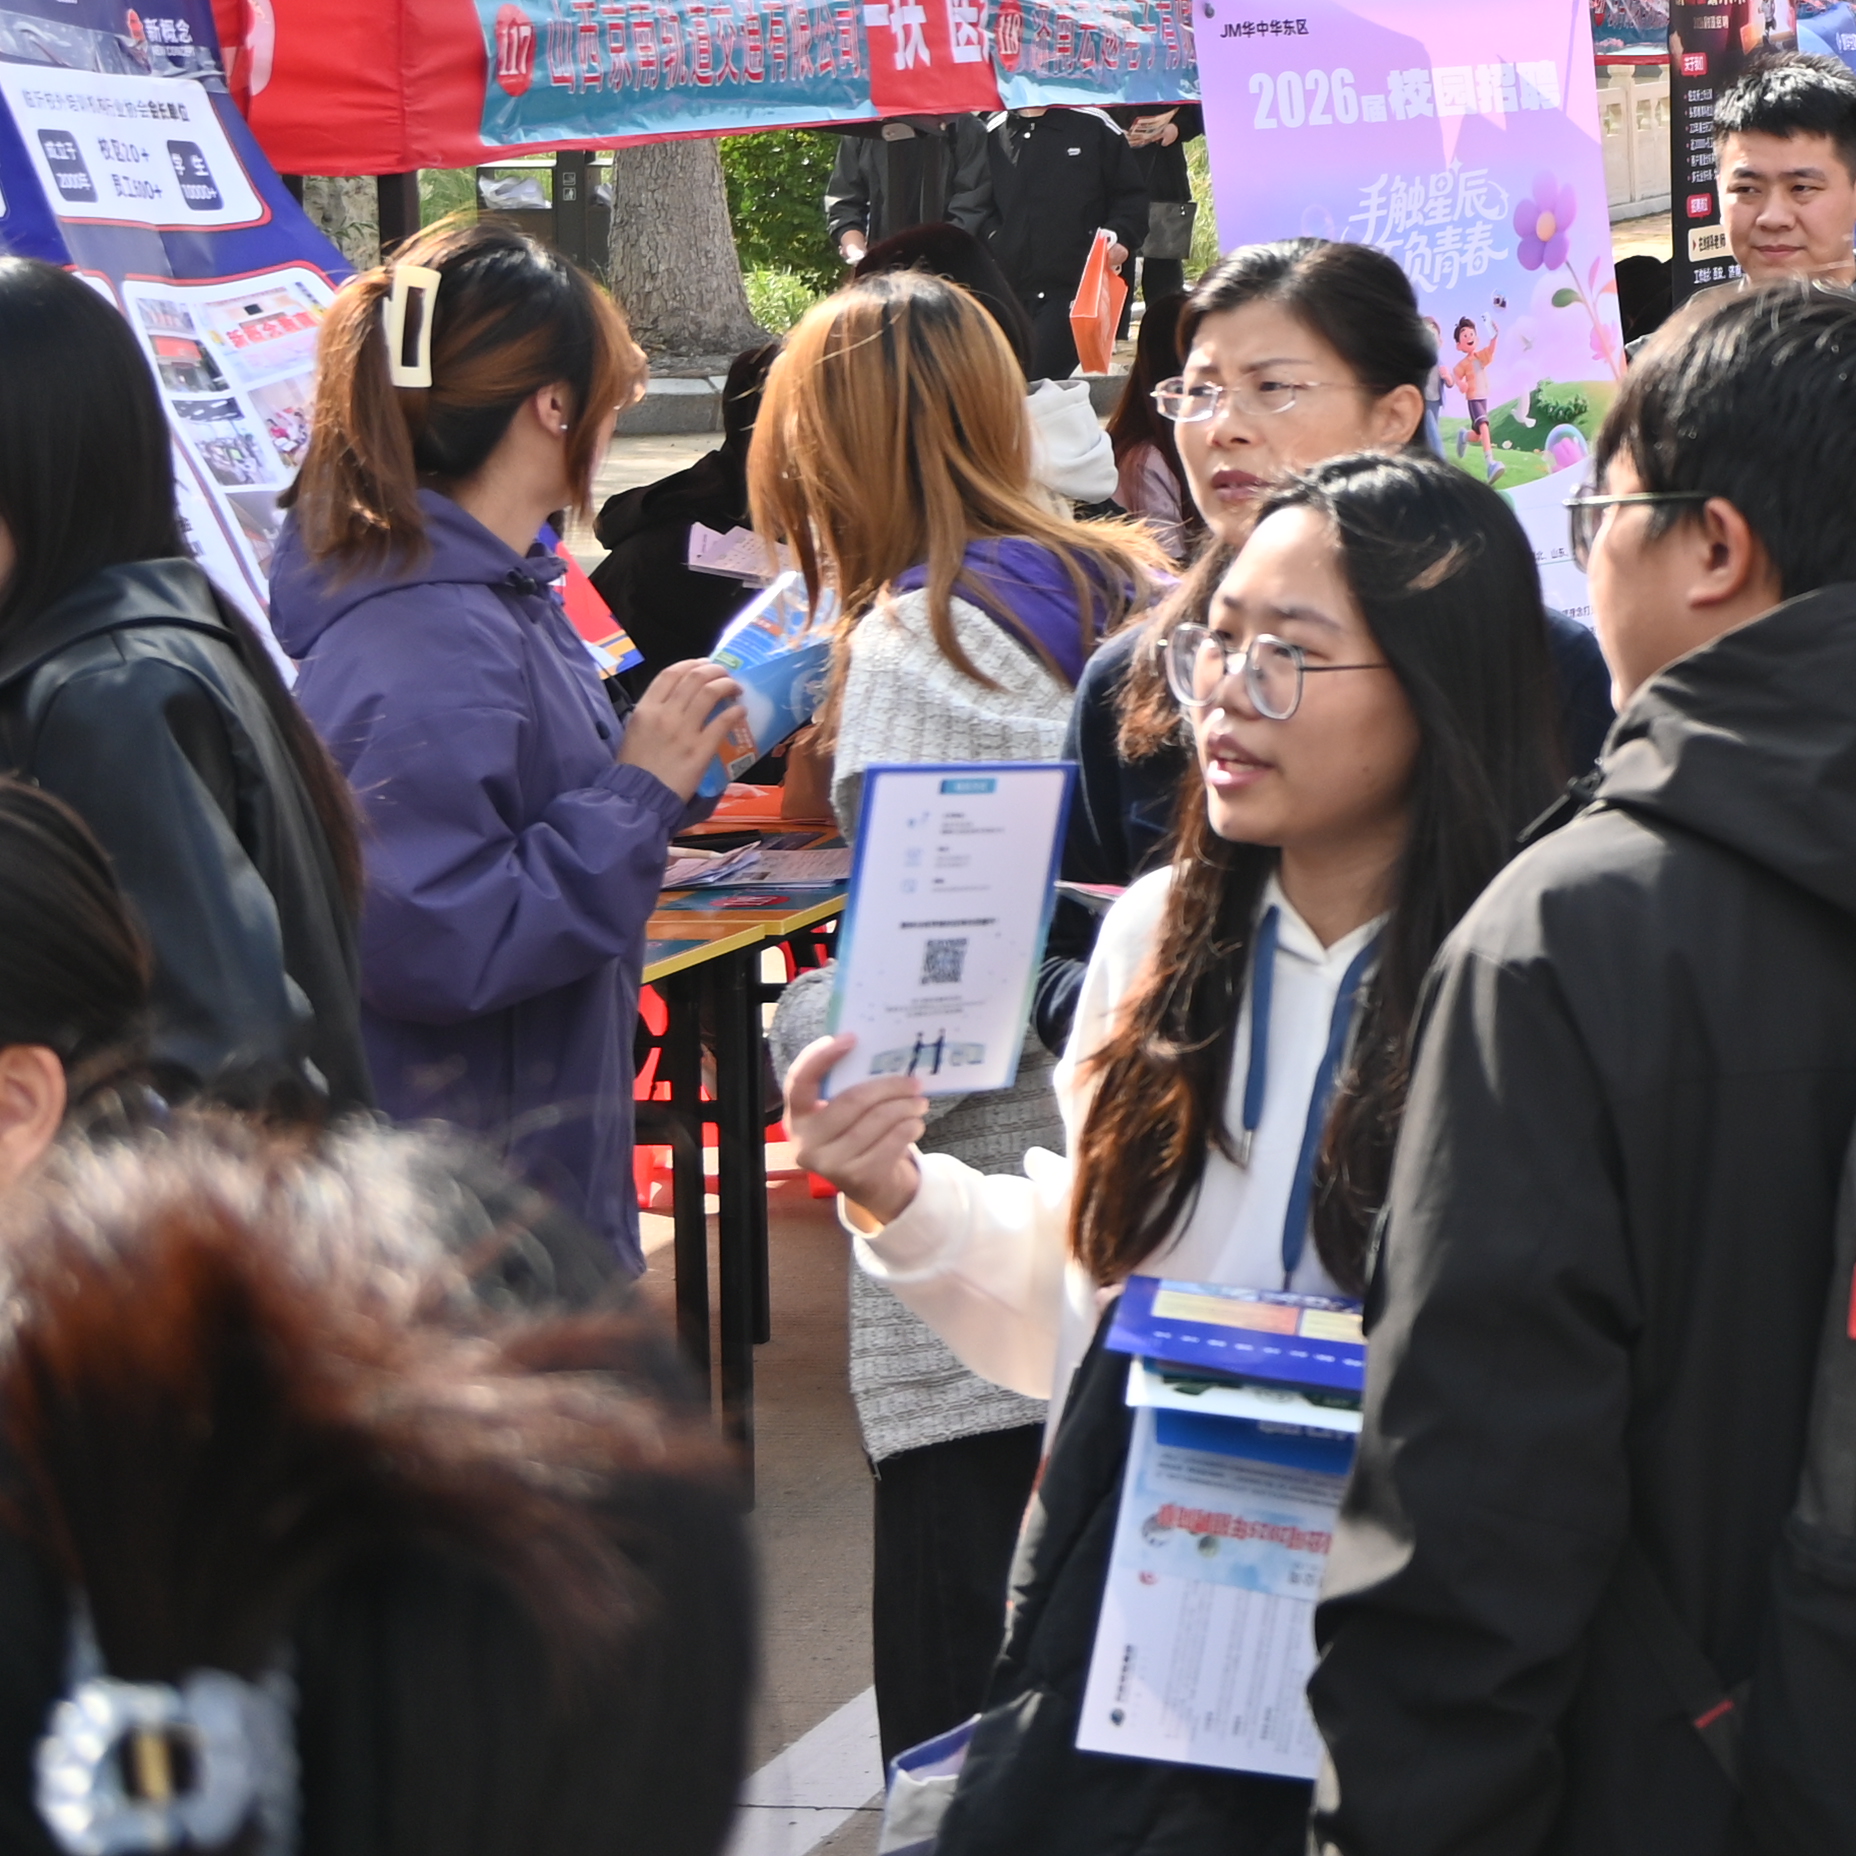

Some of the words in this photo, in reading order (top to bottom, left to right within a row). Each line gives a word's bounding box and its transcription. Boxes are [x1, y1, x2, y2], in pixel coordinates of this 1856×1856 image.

[143, 18, 193, 43] 新概念
[1220, 19, 1309, 38] JM华中华东区
[500, 22, 531, 76] 117
[1249, 60, 1562, 131] 2026届校园招聘
[99, 138, 150, 163] 校区20+
[1348, 162, 1505, 236] 手触星辰
